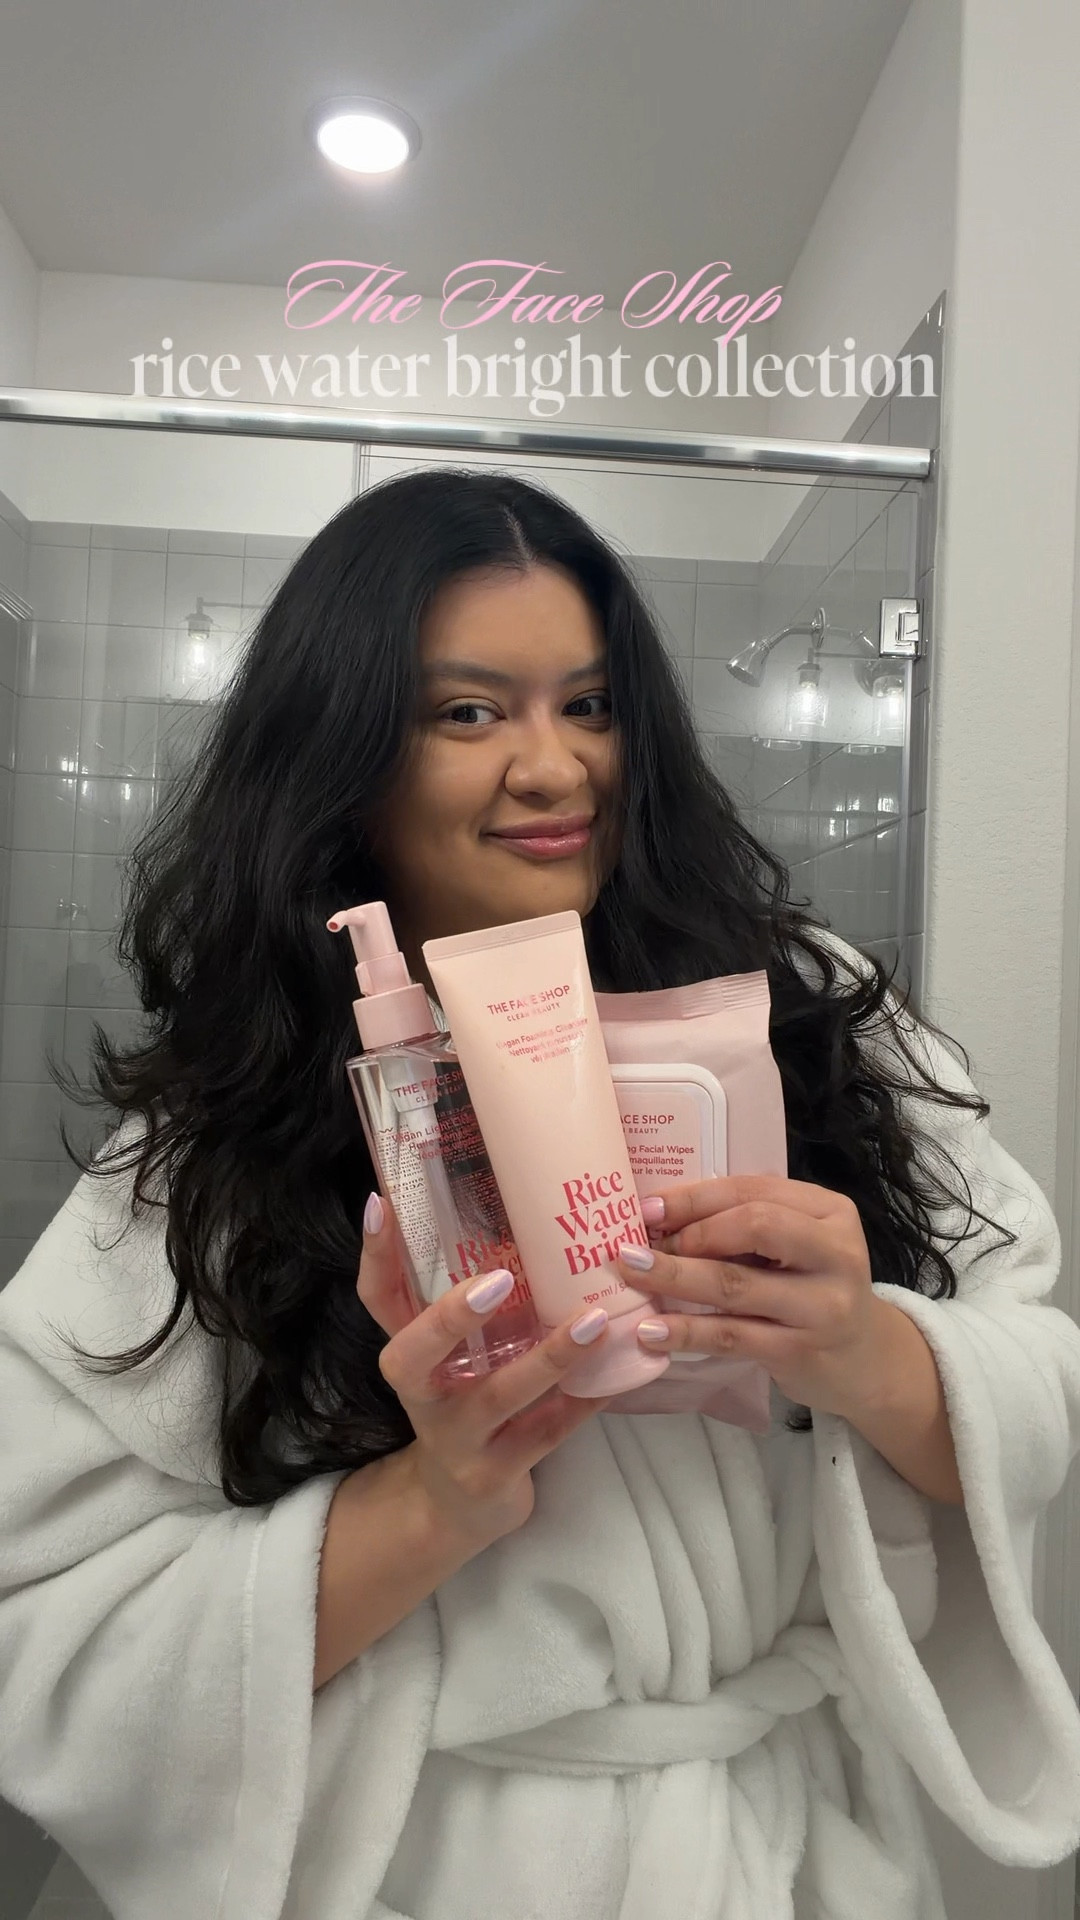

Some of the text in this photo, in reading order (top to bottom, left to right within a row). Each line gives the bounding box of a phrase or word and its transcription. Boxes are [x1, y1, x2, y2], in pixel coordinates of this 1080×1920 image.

[487, 1003, 509, 1015] THE
[539, 985, 570, 1002] SHOP
[394, 1083, 419, 1098] THE
[421, 1074, 452, 1092] FACE
[642, 1114, 674, 1124] SHOP
[639, 1145, 664, 1153] Facial
[666, 1145, 694, 1154] Wipes
[629, 1156, 684, 1165] maquillantes
[645, 1167, 653, 1175] le
[655, 1167, 684, 1176] visage
[562, 1171, 624, 1211] Rice
[554, 1194, 637, 1241] Water
[456, 1231, 513, 1271] Rice
[582, 1292, 599, 1304] 150
[601, 1286, 613, 1298] ml
